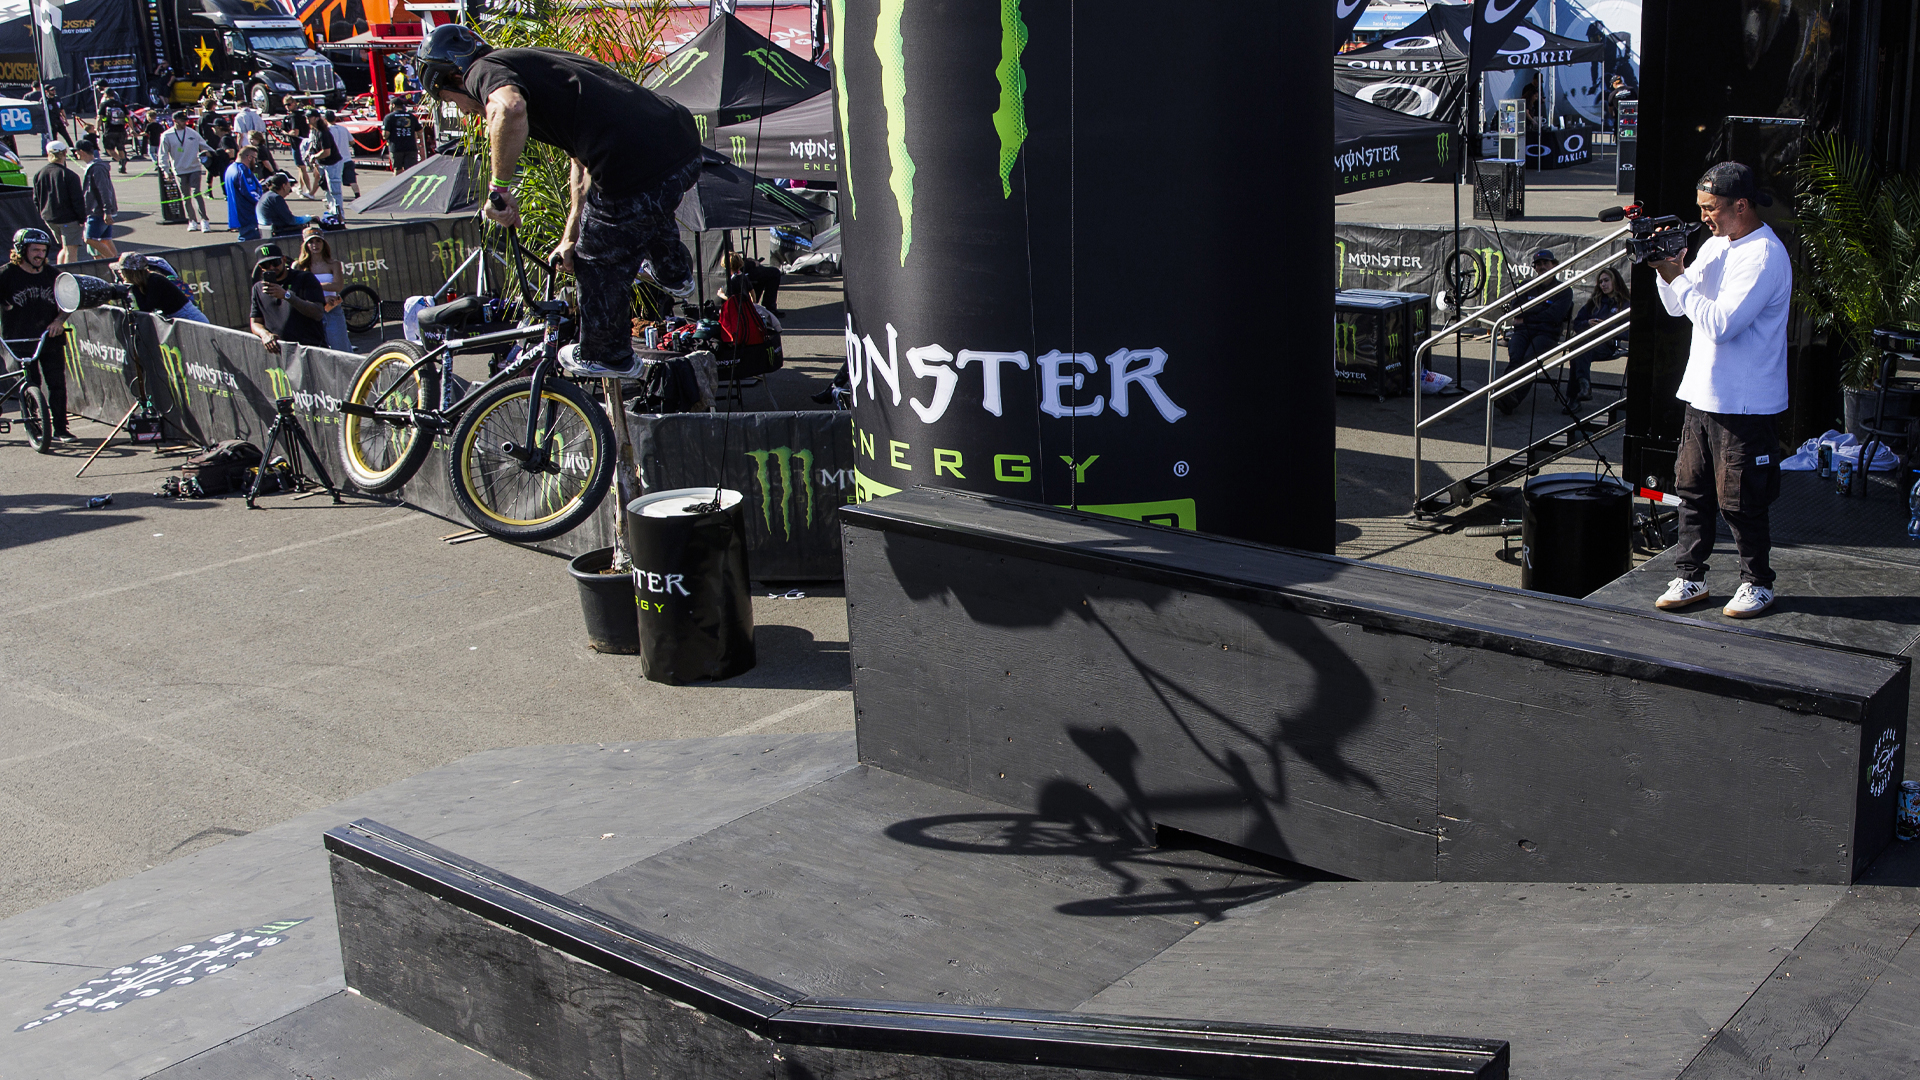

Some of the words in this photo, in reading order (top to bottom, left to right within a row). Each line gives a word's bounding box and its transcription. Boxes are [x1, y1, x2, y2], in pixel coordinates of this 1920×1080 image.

[1522, 50, 1573, 65] OAKLEY
[1370, 60, 1444, 71] OAKLEY
[1, 108, 31, 128] PPG
[790, 139, 836, 160] MONS
[1557, 150, 1588, 164] OAKLEY
[1334, 145, 1400, 173] MONSTER
[804, 163, 837, 171] ENE
[1344, 169, 1392, 184] ENERGY
[1348, 252, 1423, 269] MONSTER
[1360, 269, 1411, 277] ENERGY
[79, 339, 128, 365] MONSTER
[91, 360, 124, 375] ENERGY
[845, 313, 1188, 424] ONSTER
[1335, 369, 1367, 380] ONSTER
[186, 361, 239, 390] MONSTER
[292, 389, 336, 412] MONS
[305, 413, 340, 425] ENER
